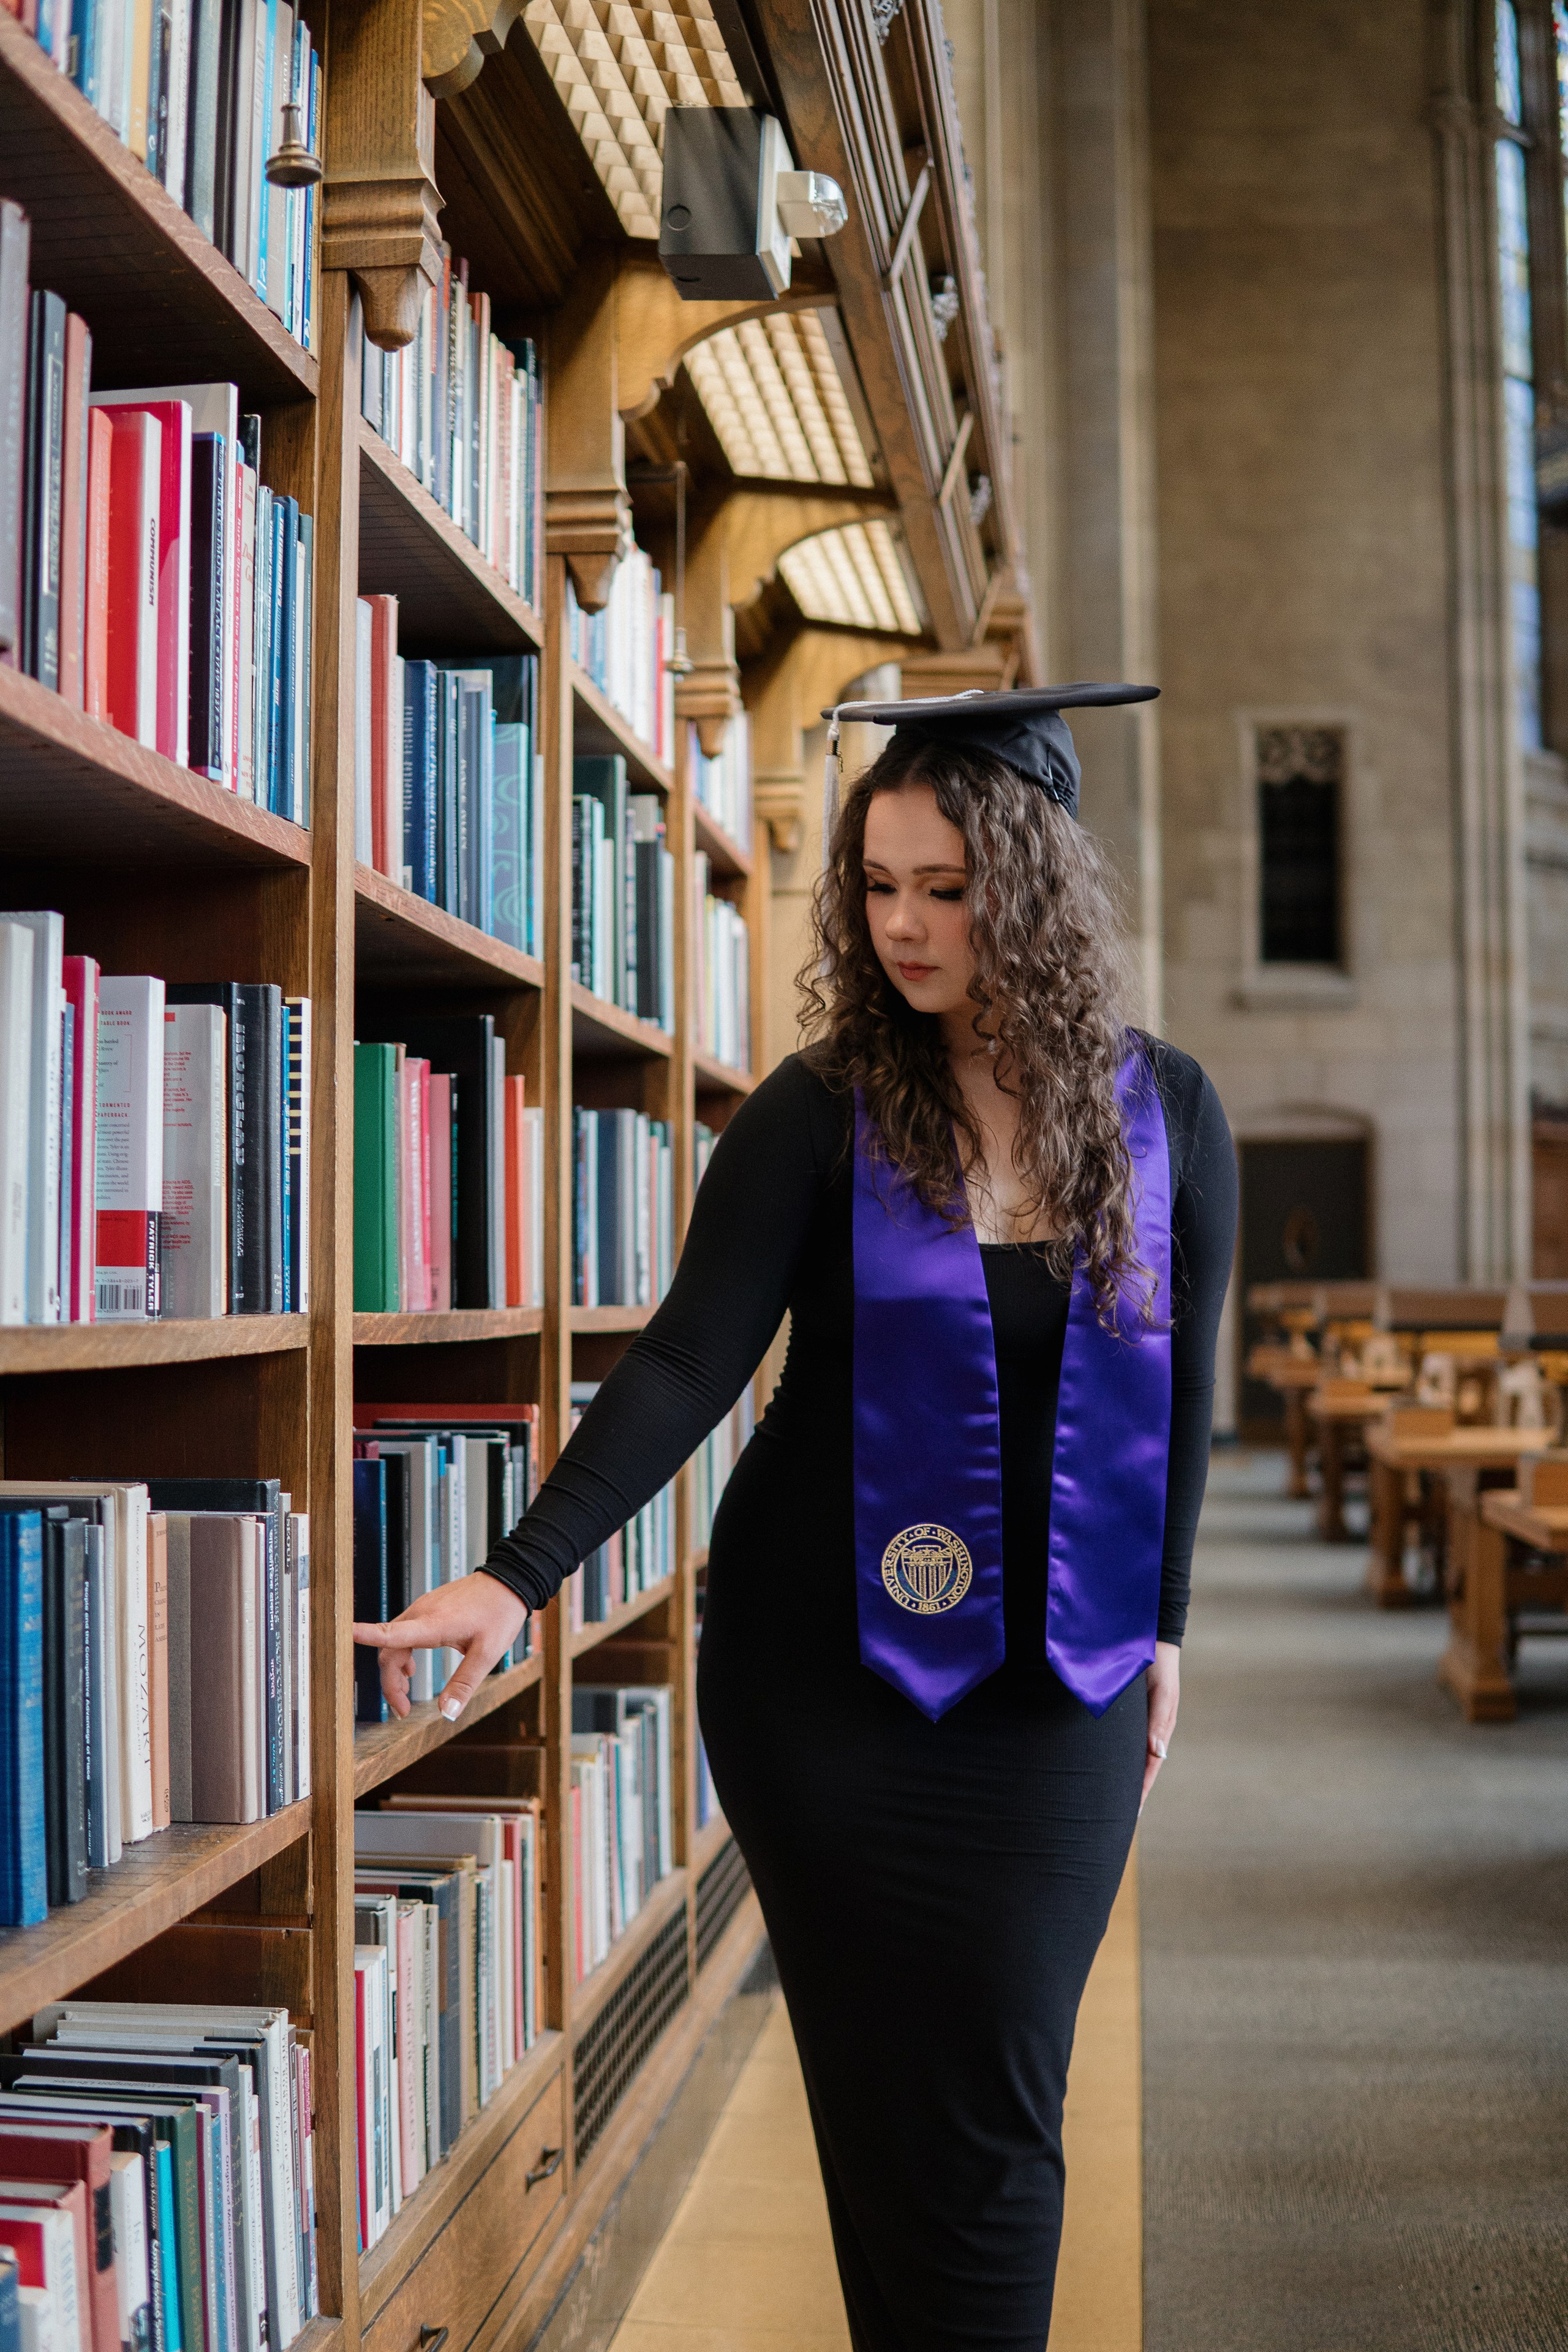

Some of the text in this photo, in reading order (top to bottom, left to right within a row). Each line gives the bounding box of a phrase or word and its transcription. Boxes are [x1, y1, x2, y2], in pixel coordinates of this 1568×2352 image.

[236, 597, 239, 611] on
[235, 665, 239, 679] of
[235, 1023, 246, 1165] IRONCLAD
[883, 1526, 971, 1607] UNIVERSITY OF WASHINGTON
[917, 1602, 941, 1612] 1861
[138, 1624, 151, 1770] MOZART
[276, 1631, 284, 1755] SKETCHBOOK
[86, 1745, 91, 1754] of
[227, 2195, 231, 2206] of
[284, 2143, 288, 2160] OF
[287, 2201, 297, 2309] MENDELSSOHNS
[151, 2238, 162, 2318] Compressed
